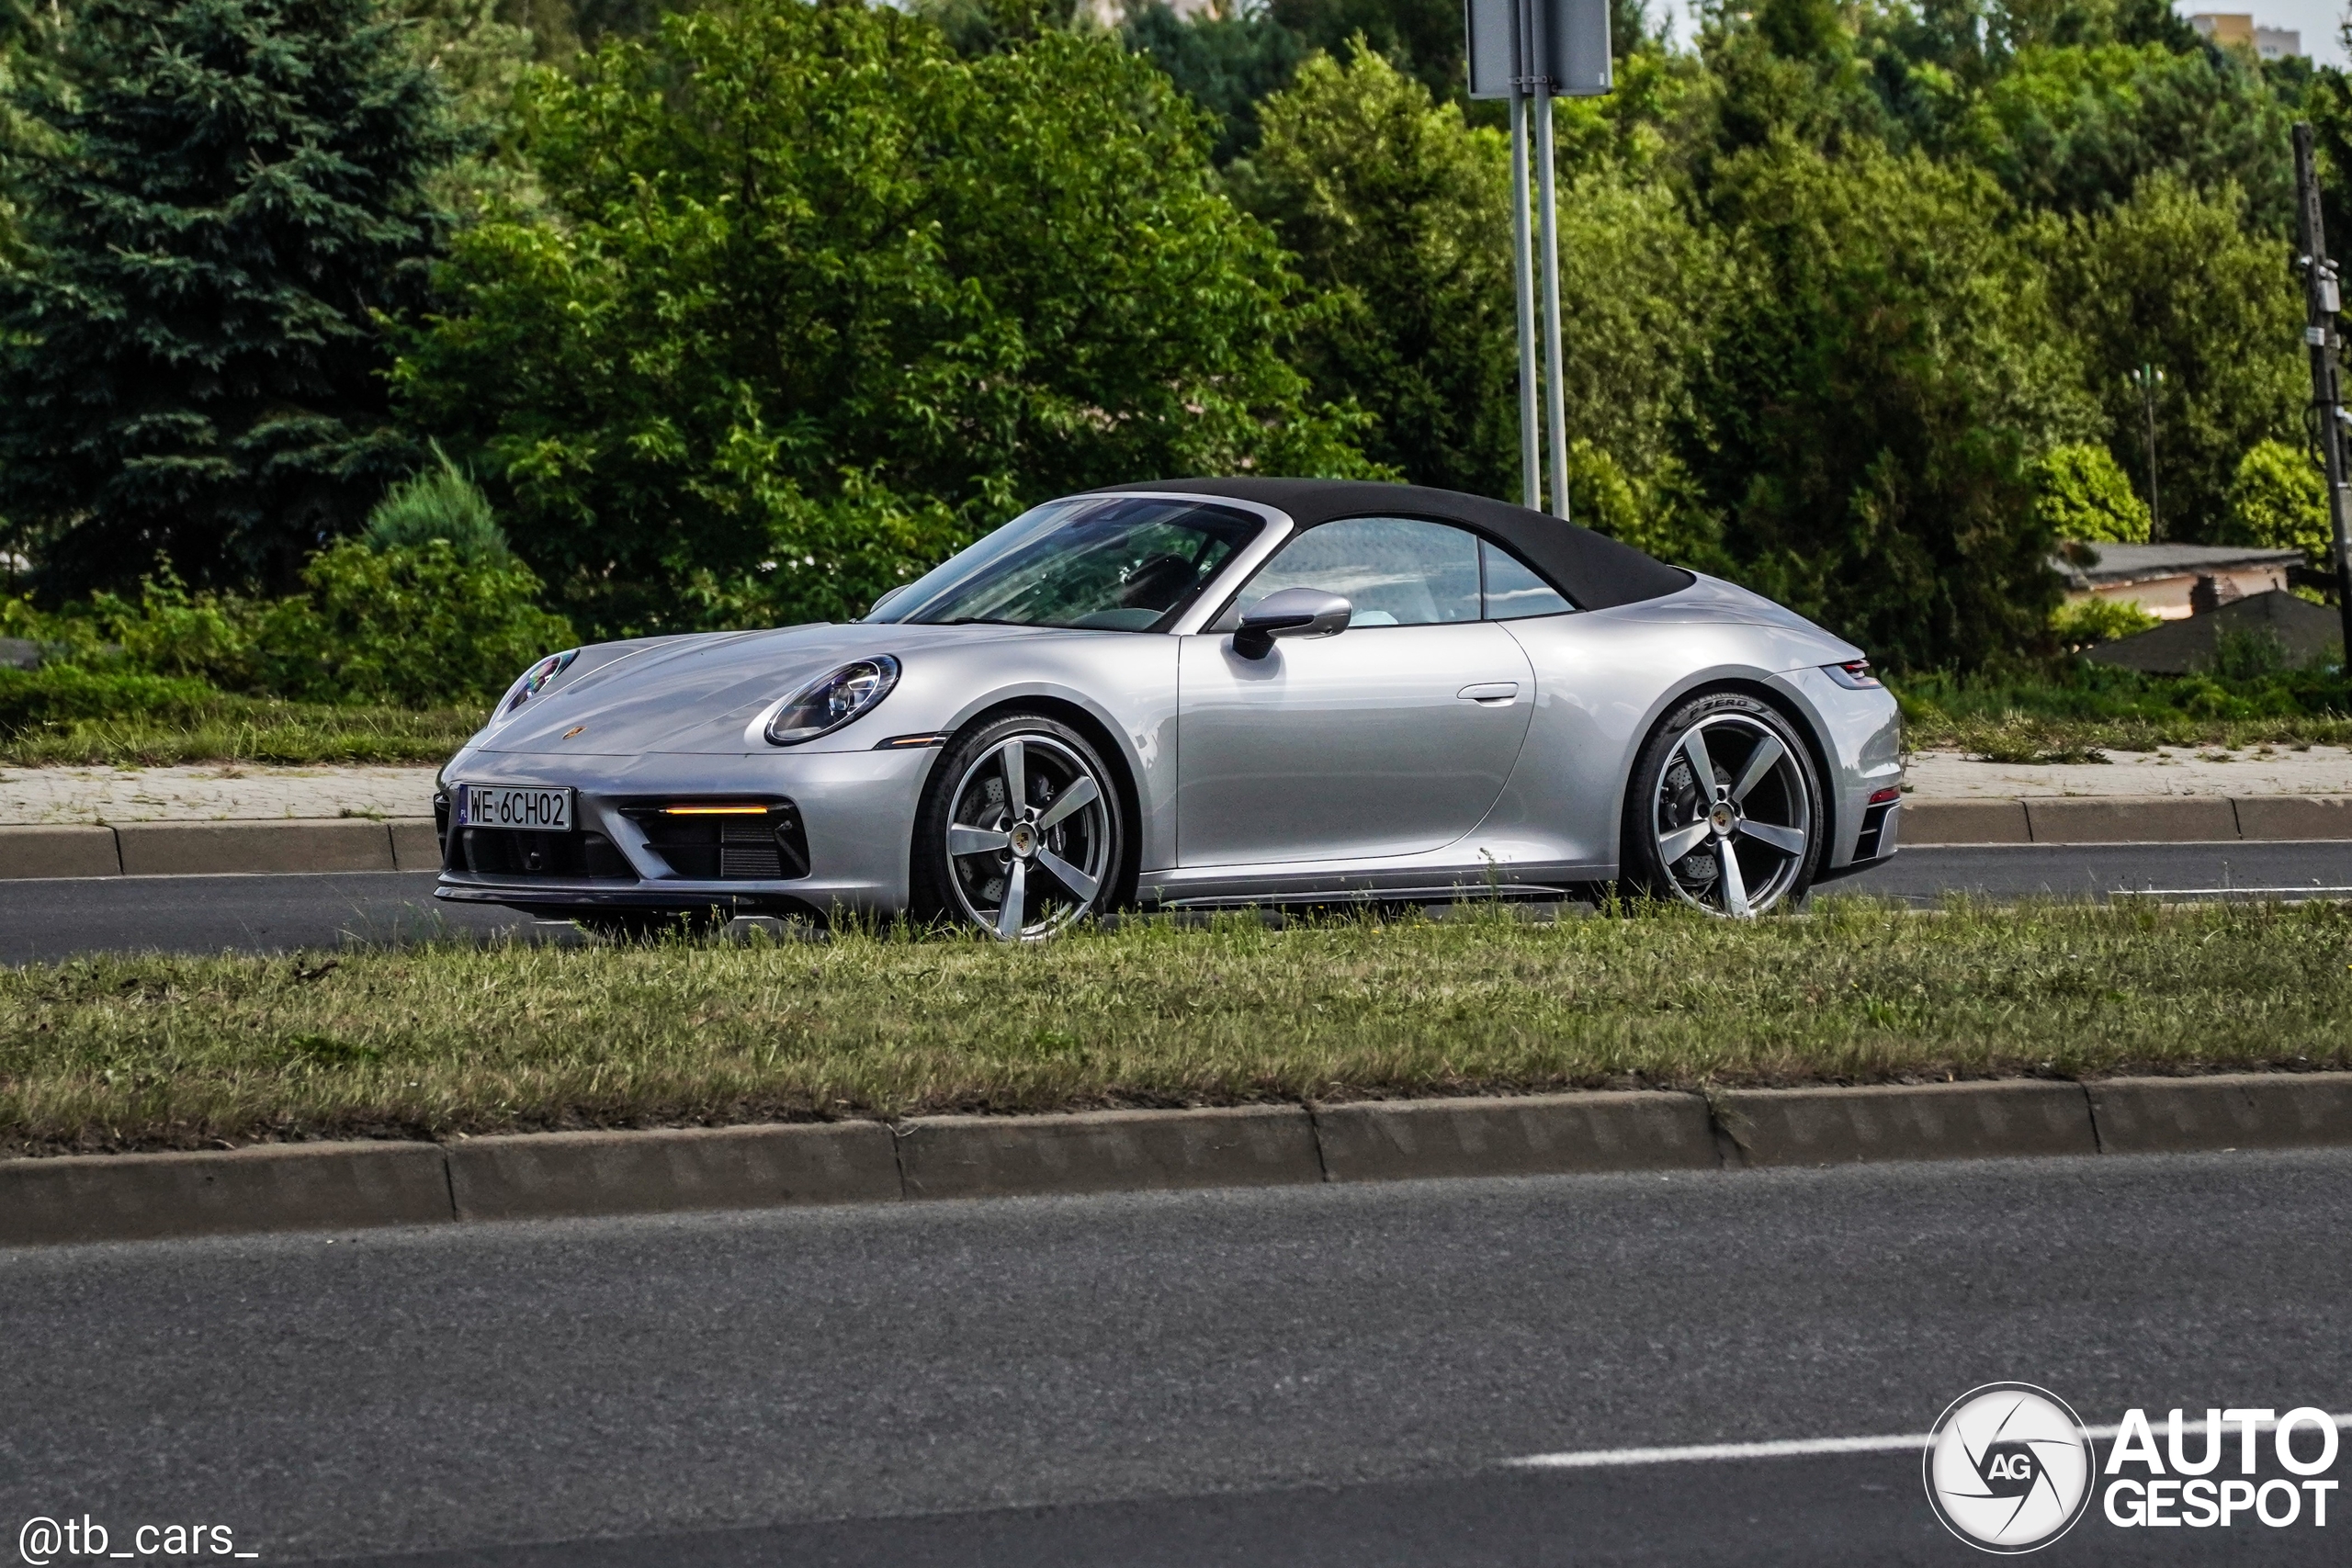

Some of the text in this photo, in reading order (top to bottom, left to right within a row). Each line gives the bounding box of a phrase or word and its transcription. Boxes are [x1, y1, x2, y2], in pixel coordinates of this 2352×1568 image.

[1703, 699, 1748, 710] ZERO
[470, 790, 564, 826] WE 6CH02
